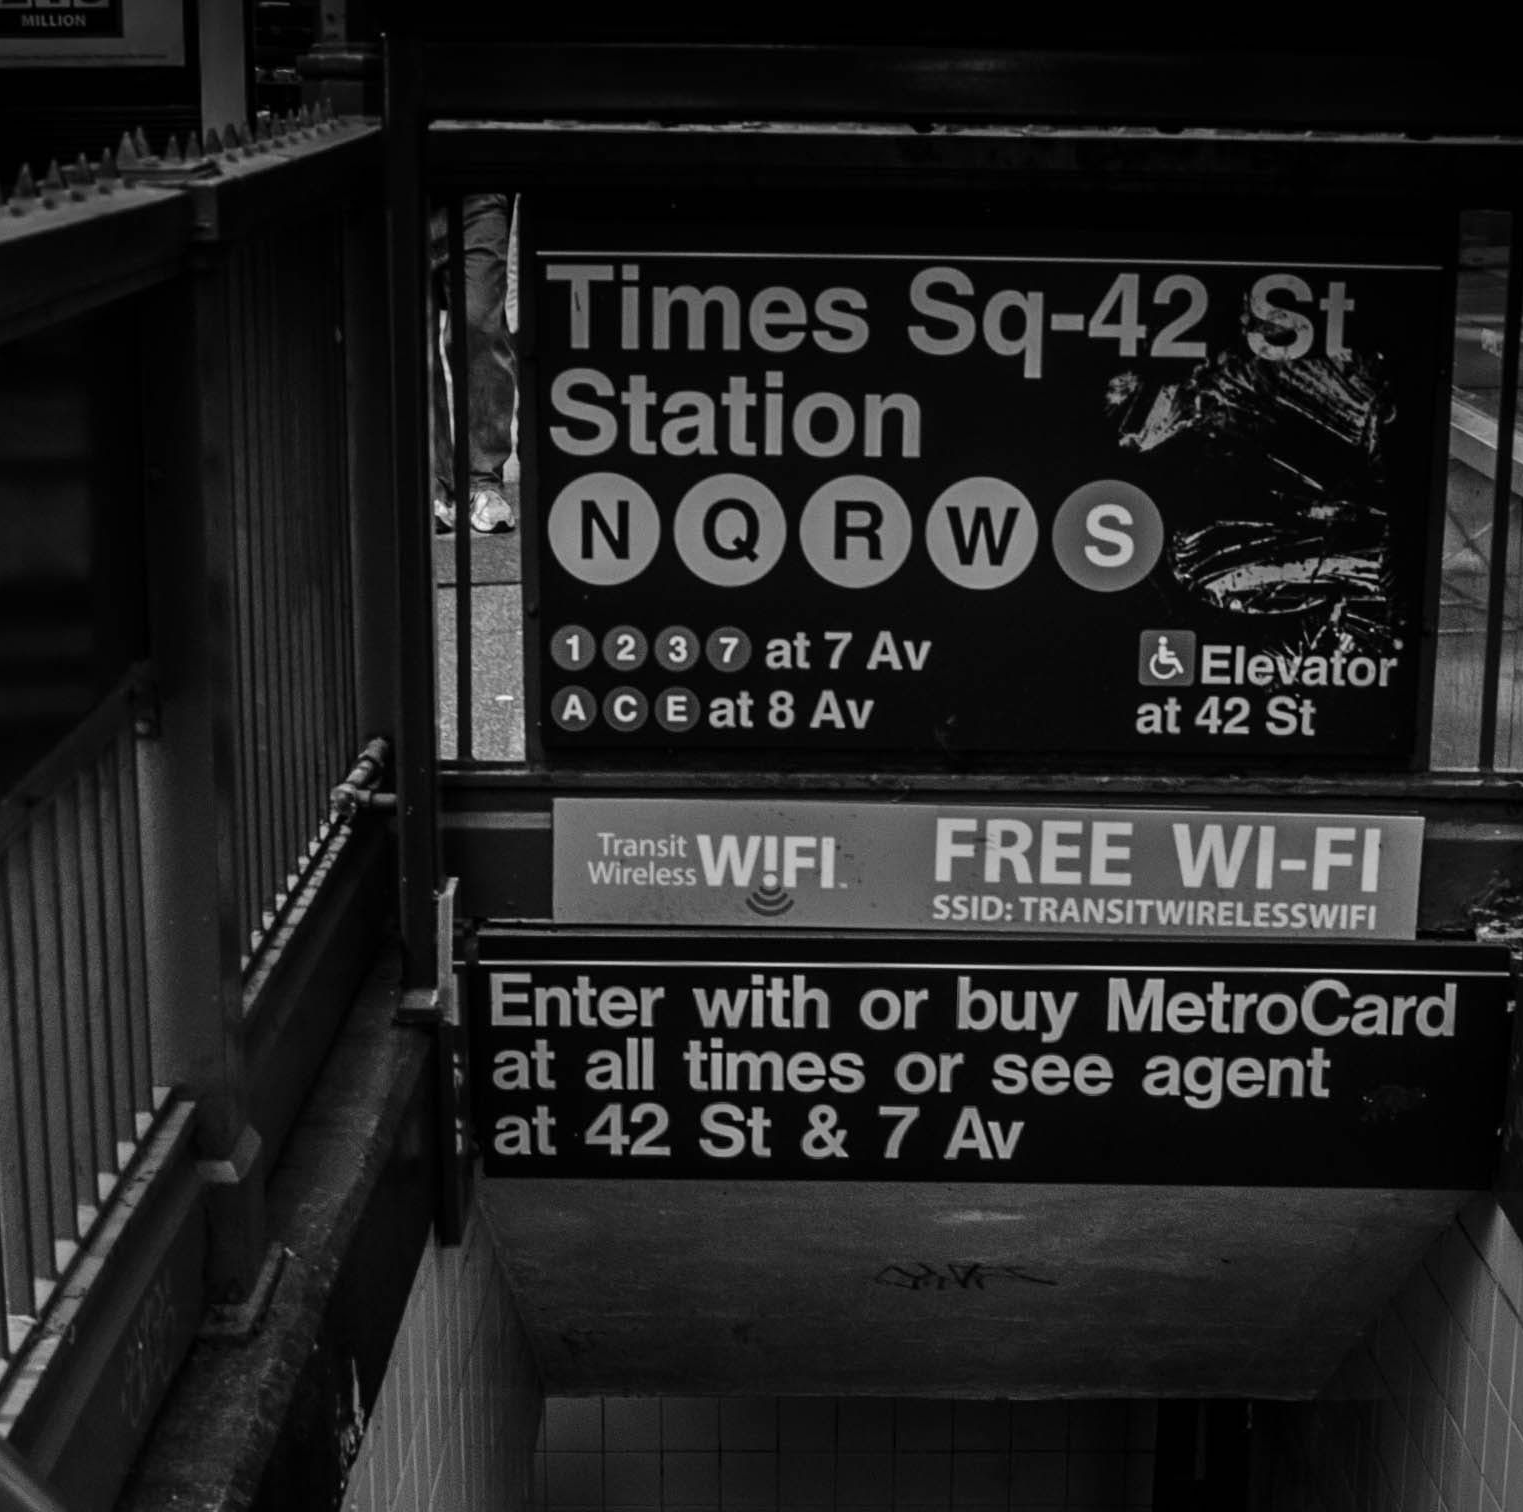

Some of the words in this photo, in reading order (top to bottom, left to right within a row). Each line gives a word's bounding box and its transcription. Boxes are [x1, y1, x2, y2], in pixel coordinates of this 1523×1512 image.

[21, 13, 87, 28] MILLION
[546, 264, 869, 354] Times
[908, 266, 1210, 380] Sq-42
[1246, 273, 1355, 360] St
[549, 368, 921, 458] Station
[581, 499, 630, 561] N
[702, 499, 759, 564] Q
[833, 501, 883, 562] R
[945, 505, 1019, 567] W
[1084, 503, 1136, 568] S
[566, 634, 580, 661] 1
[617, 634, 636, 661] 2
[668, 636, 688, 663] 3
[718, 637, 739, 663] 7
[766, 632, 811, 669] at
[823, 632, 853, 669] 7
[867, 631, 932, 670] Av
[1201, 645, 1398, 687] Elevator
[562, 694, 586, 721] A
[613, 695, 638, 722] C
[666, 696, 688, 722] E
[709, 691, 754, 728] at
[768, 690, 795, 728] 8
[810, 690, 875, 729] Av
[1135, 697, 1182, 734] at
[1195, 696, 1251, 735] 42
[1265, 696, 1316, 736] St
[596, 832, 688, 858] Transit
[935, 818, 1134, 887] FREE
[1172, 823, 1382, 892] WI-FI
[587, 860, 697, 887] Wireless
[932, 894, 1013, 922] SSID:
[1018, 896, 1378, 930] TRANSITWIRELESSWIFI
[489, 972, 666, 1029] Enter
[693, 974, 831, 1031] with
[859, 988, 929, 1033] or
[956, 975, 1077, 1045] buy
[1106, 977, 1458, 1039] MetroCard
[492, 1038, 556, 1091] at
[585, 1036, 655, 1092] all
[683, 1037, 866, 1095] times
[894, 1051, 965, 1095] or
[991, 1052, 1114, 1097] see
[1141, 1047, 1331, 1110] agent
[493, 1105, 556, 1157] at
[584, 1103, 671, 1158] 42
[699, 1104, 772, 1159] St
[801, 1105, 849, 1159] &
[878, 1106, 920, 1159] 7
[944, 1107, 1025, 1160] Av
